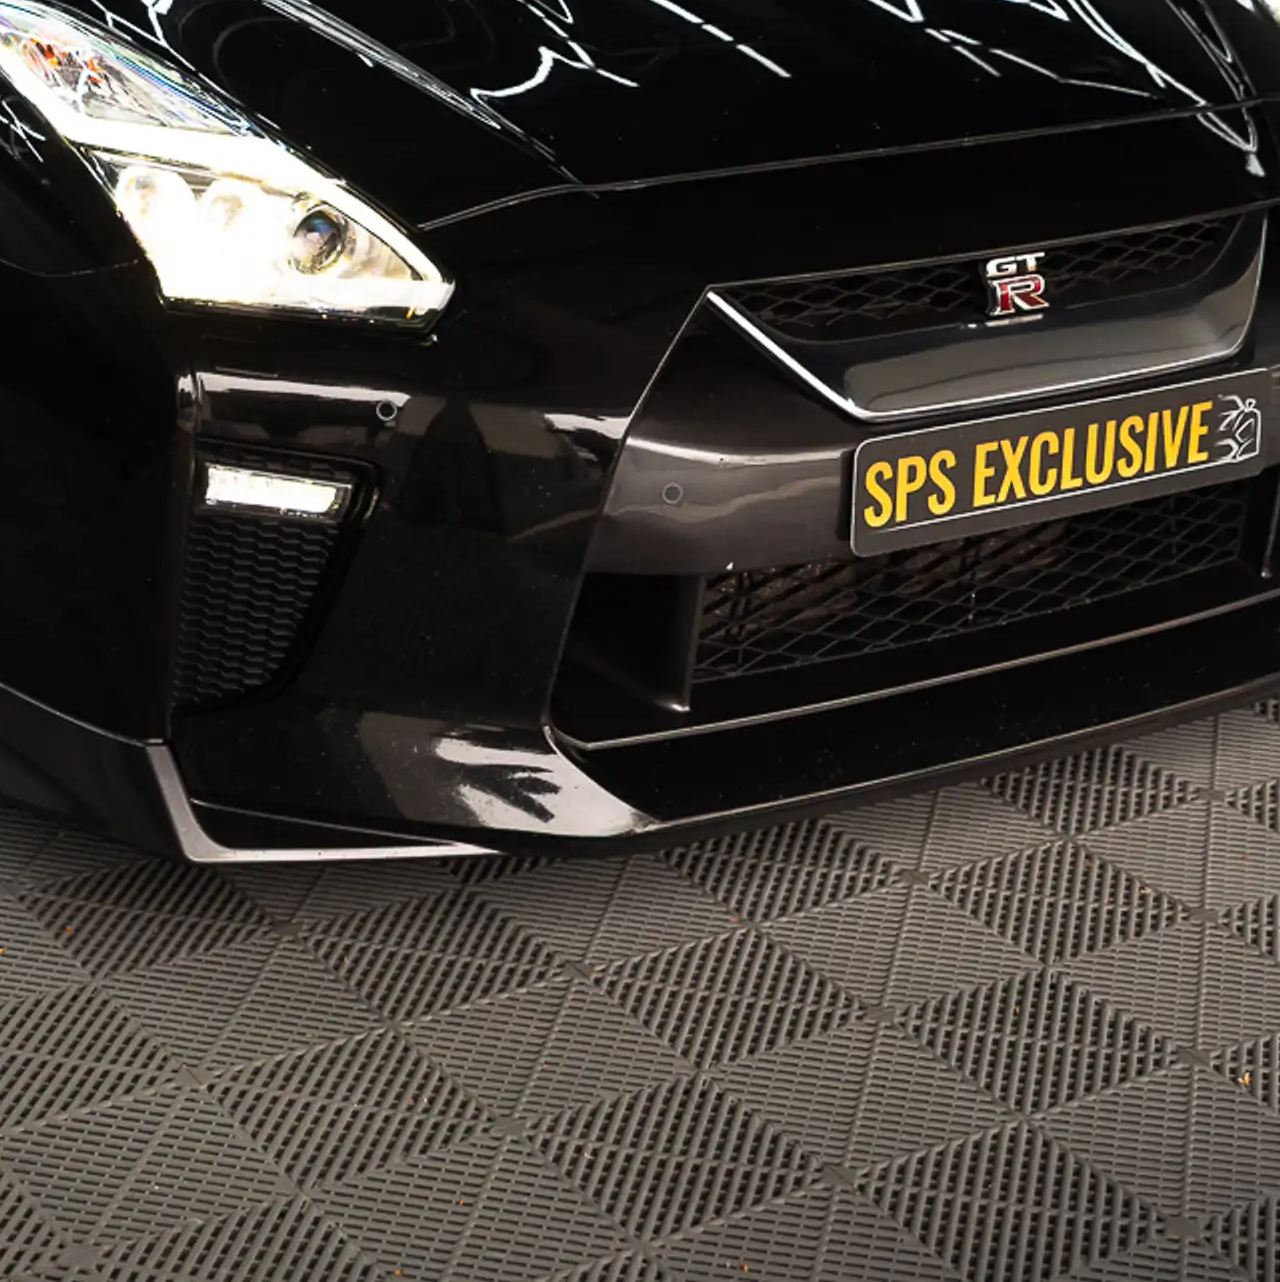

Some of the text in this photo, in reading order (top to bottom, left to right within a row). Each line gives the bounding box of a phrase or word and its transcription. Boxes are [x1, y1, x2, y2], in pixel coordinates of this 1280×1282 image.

[985, 251, 1045, 277] GT
[988, 274, 1050, 316] R
[863, 400, 1213, 528] SPS EXCLUSIVE
